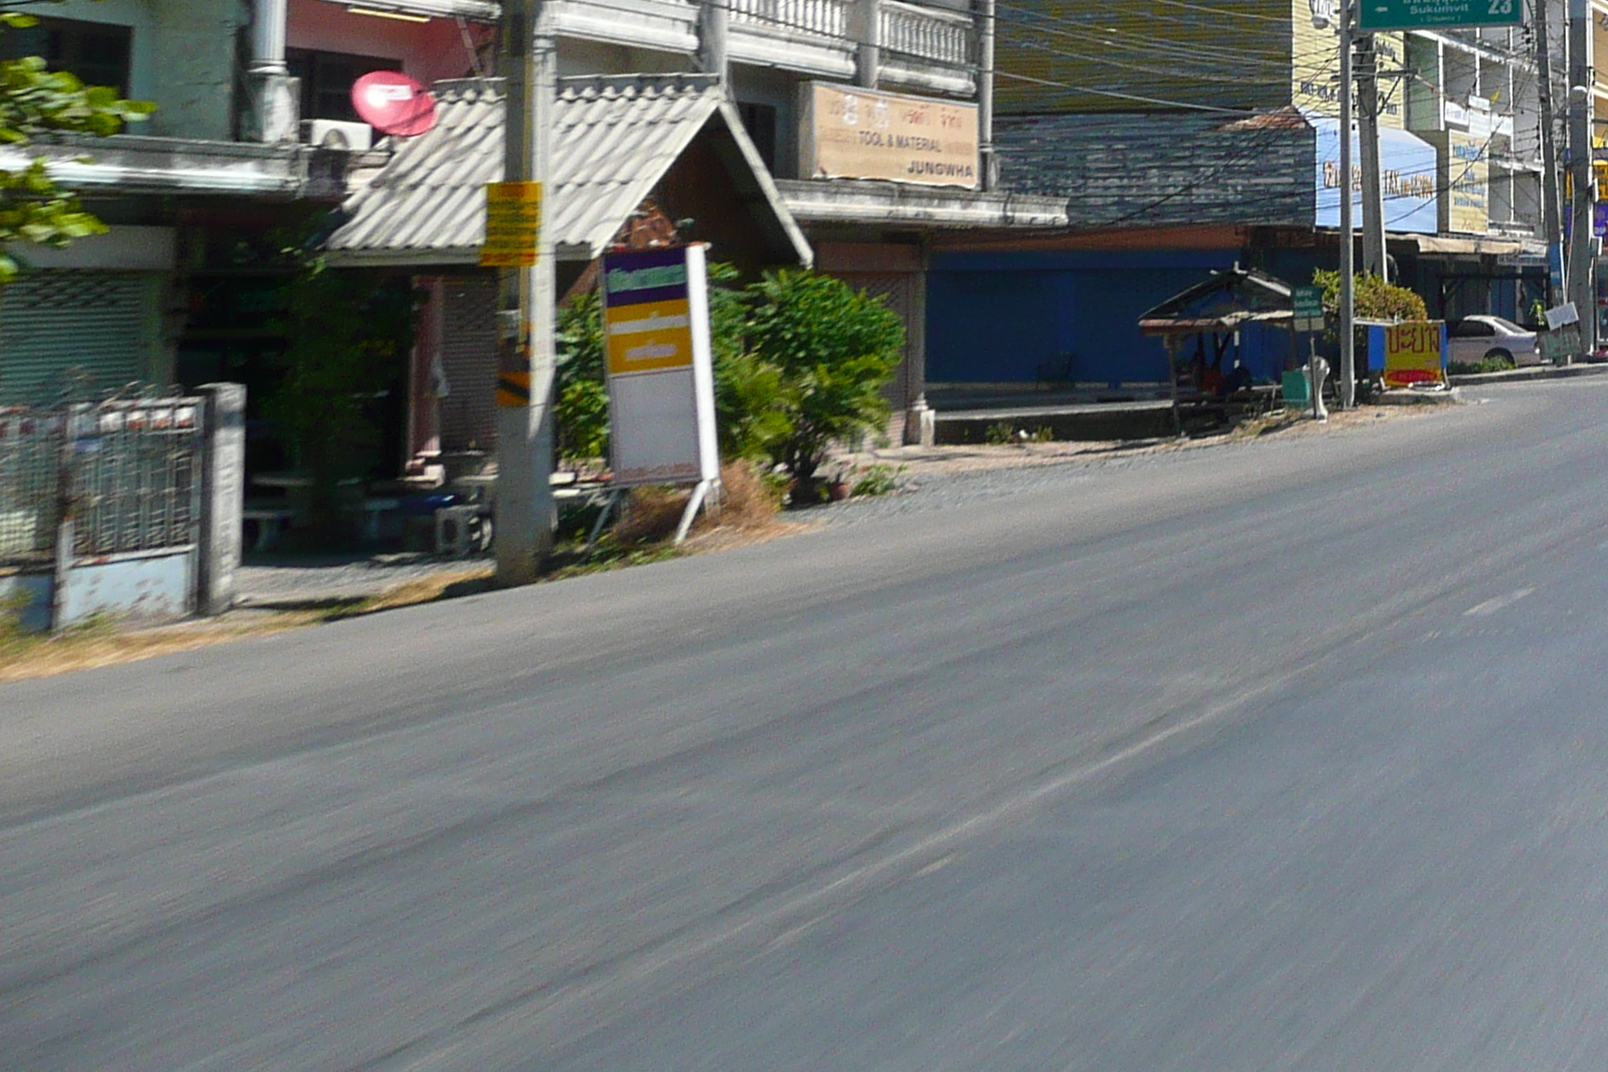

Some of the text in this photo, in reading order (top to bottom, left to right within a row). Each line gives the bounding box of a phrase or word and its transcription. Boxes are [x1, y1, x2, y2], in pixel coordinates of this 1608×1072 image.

[1409, 3, 1470, 15] Sukumvit
[857, 130, 942, 154] TOOL & MATERIAL
[907, 159, 974, 179] JUNGWHA
[1386, 325, 1441, 354] ปะยาง
